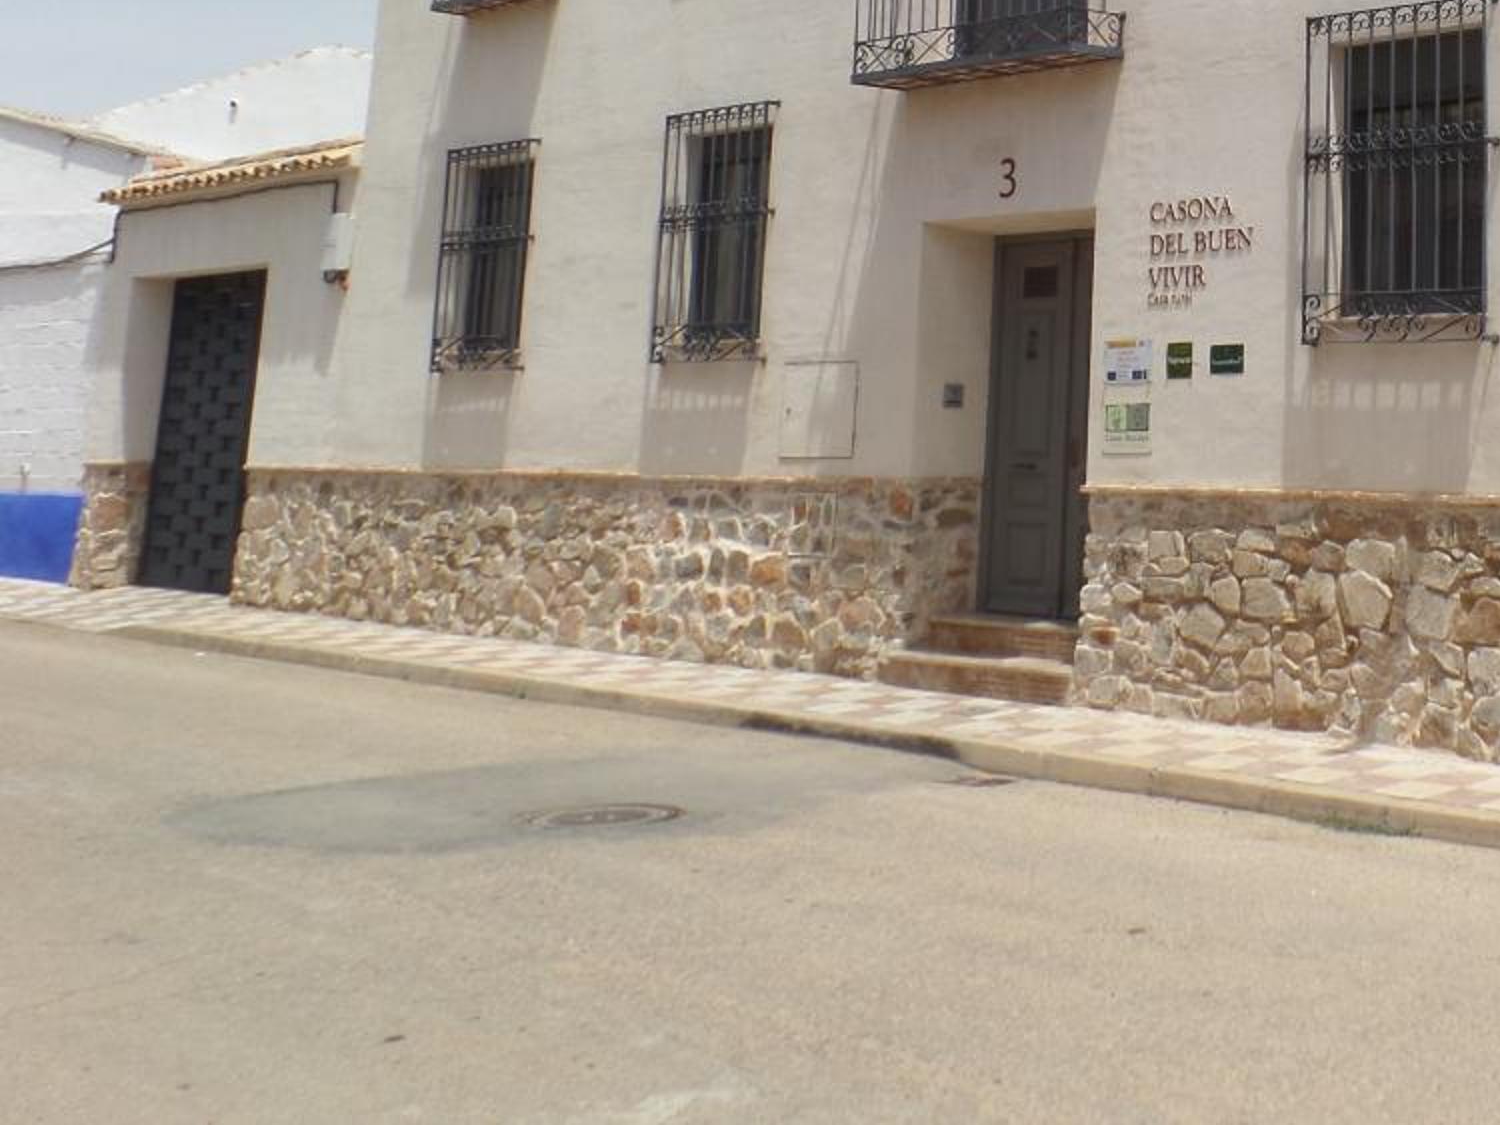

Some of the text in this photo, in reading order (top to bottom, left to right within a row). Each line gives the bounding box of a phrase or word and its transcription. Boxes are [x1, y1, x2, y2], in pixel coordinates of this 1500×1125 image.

[1000, 158, 1017, 198] 3
[1150, 196, 1233, 223] CASONA
[1150, 227, 1253, 256] DEL BUEN
[1148, 265, 1206, 288] VIVIR
